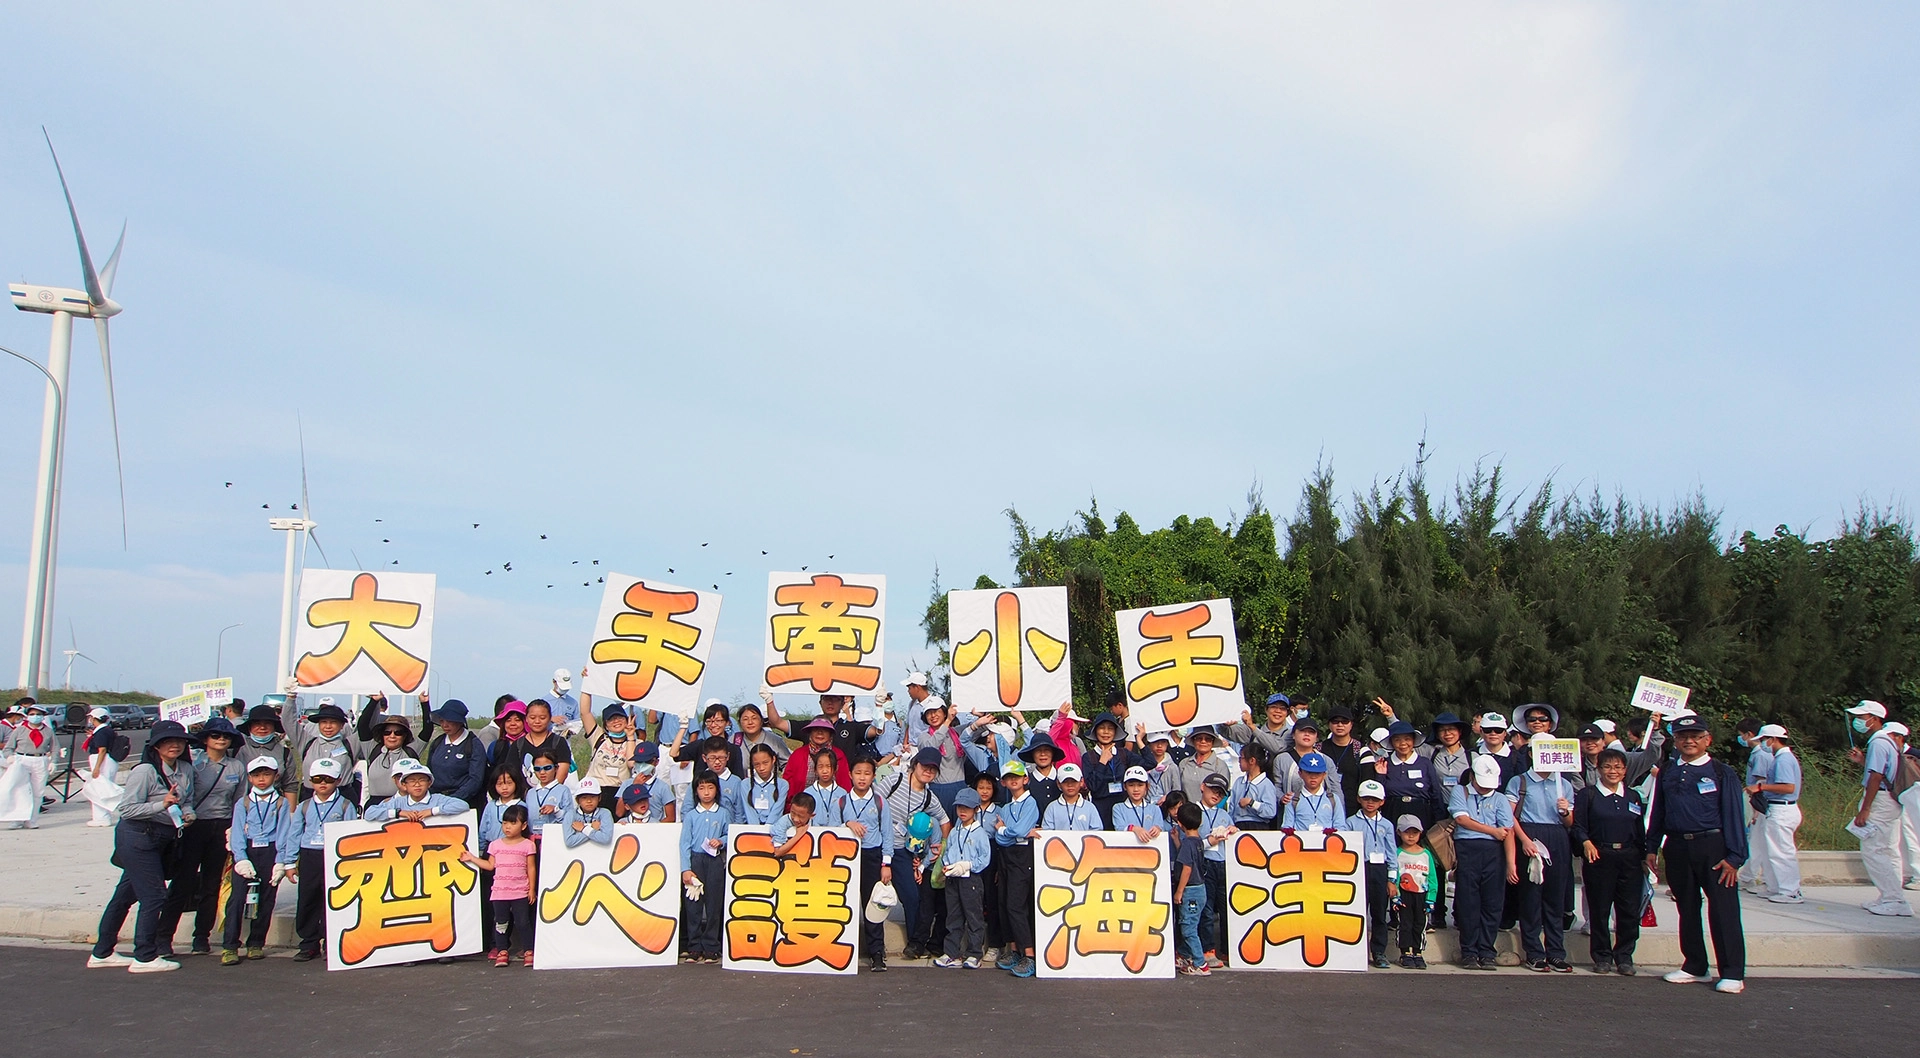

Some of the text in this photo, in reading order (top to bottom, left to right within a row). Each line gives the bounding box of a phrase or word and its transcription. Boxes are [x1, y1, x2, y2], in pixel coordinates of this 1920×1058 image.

[296, 573, 427, 693] 大
[592, 581, 705, 701] 手
[766, 575, 881, 692] 牽
[953, 592, 1067, 707] 小
[1128, 604, 1238, 726] 手
[168, 704, 201, 722] 和美班
[1540, 752, 1573, 764] 和美班
[1640, 689, 1678, 709] 和美班
[328, 819, 478, 965] 齊
[541, 834, 677, 954] 心
[726, 832, 859, 970] 護
[1038, 836, 1170, 973] 海
[1230, 833, 1364, 967] 洋
